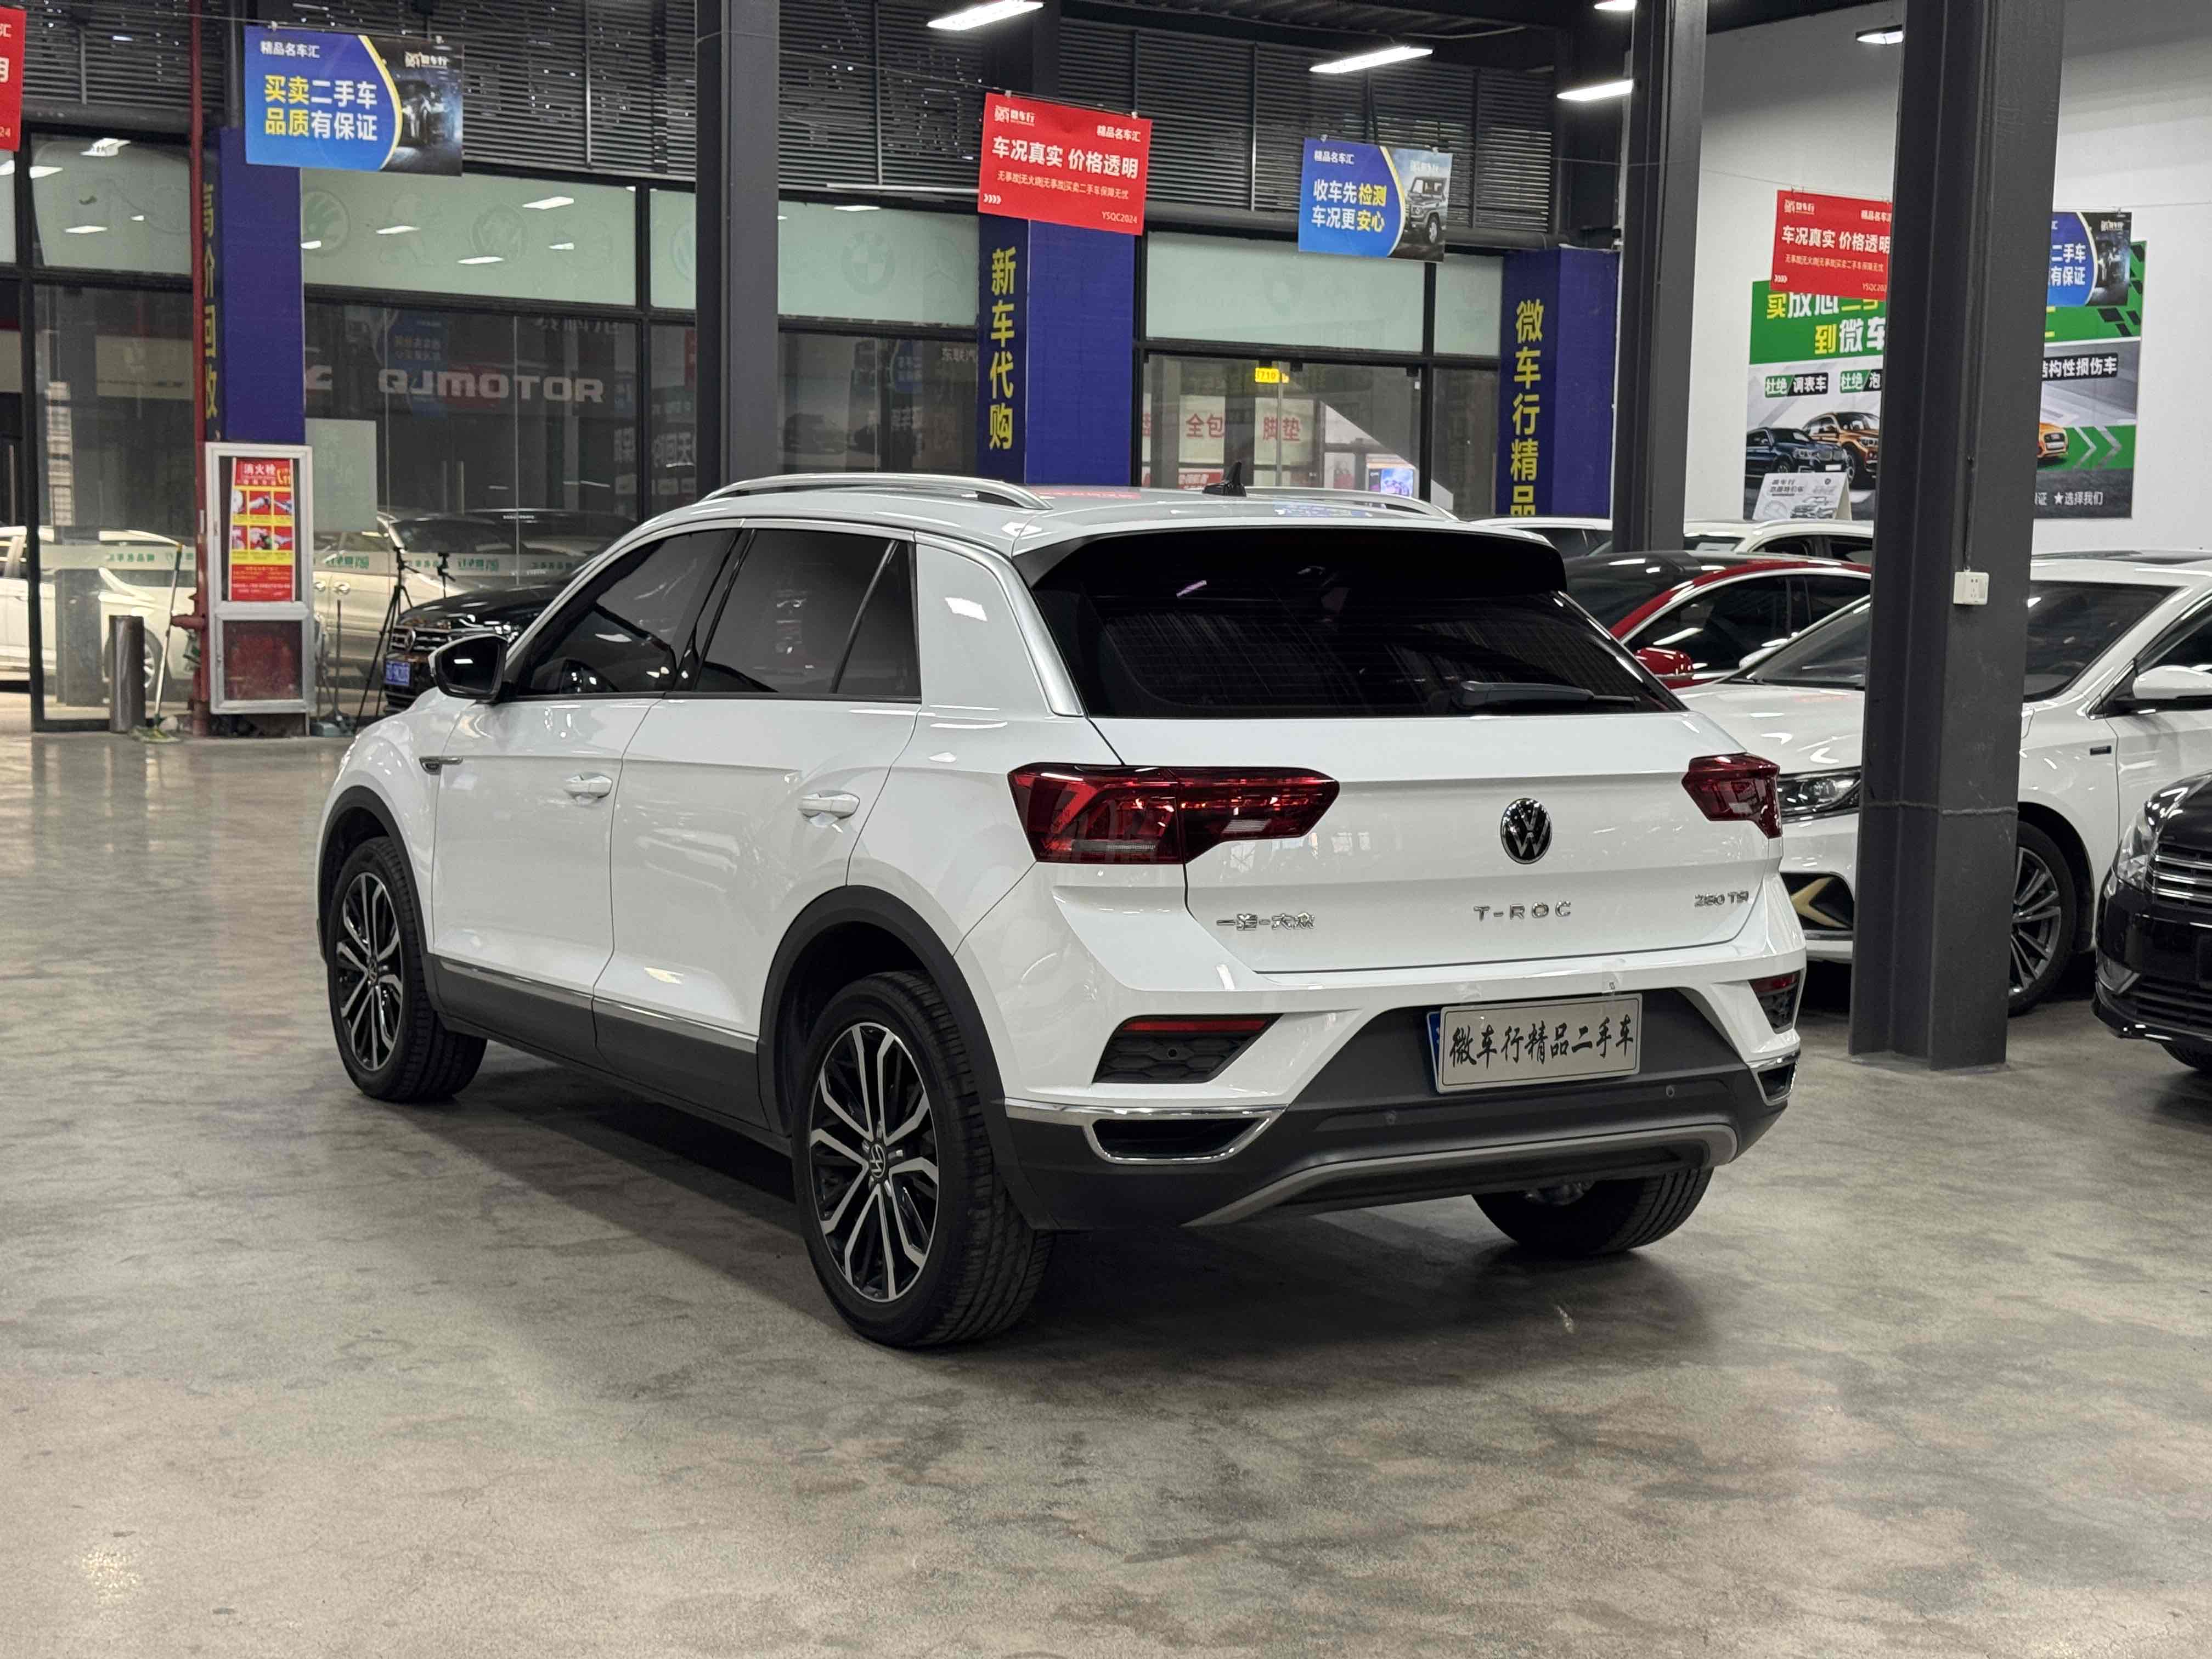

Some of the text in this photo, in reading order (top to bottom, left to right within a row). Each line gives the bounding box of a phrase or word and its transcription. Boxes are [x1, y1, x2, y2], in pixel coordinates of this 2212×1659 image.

[260, 41, 320, 58] 精品名车汇
[264, 75, 377, 109] 买卖二手车
[265, 108, 377, 141] 品质有保证
[1097, 125, 1141, 142] 精品名车汇
[992, 136, 1138, 179] 车况真实 价格透明
[1314, 150, 1354, 165] 精品名车汇
[1313, 179, 1387, 206] 收车先检测
[1102, 211, 1137, 223] YSQC2024
[1311, 205, 1385, 232] 车况更安心
[1782, 225, 1891, 254] 车况真实 价格透明
[2051, 243, 2086, 263] 二手车
[2050, 266, 2085, 286] 有保证
[989, 246, 1016, 449] 新车代购
[1814, 317, 1886, 354] 到微车
[1767, 377, 1787, 395] 杜绝
[1841, 373, 1863, 391] 杜绝
[1510, 298, 1544, 516] 微车行精品
[1186, 413, 1224, 438] 全包
[2064, 492, 2103, 506] 选择我们
[1473, 901, 1571, 922] T-ROC
[1449, 1013, 1634, 1069] 微车行精品二手车
